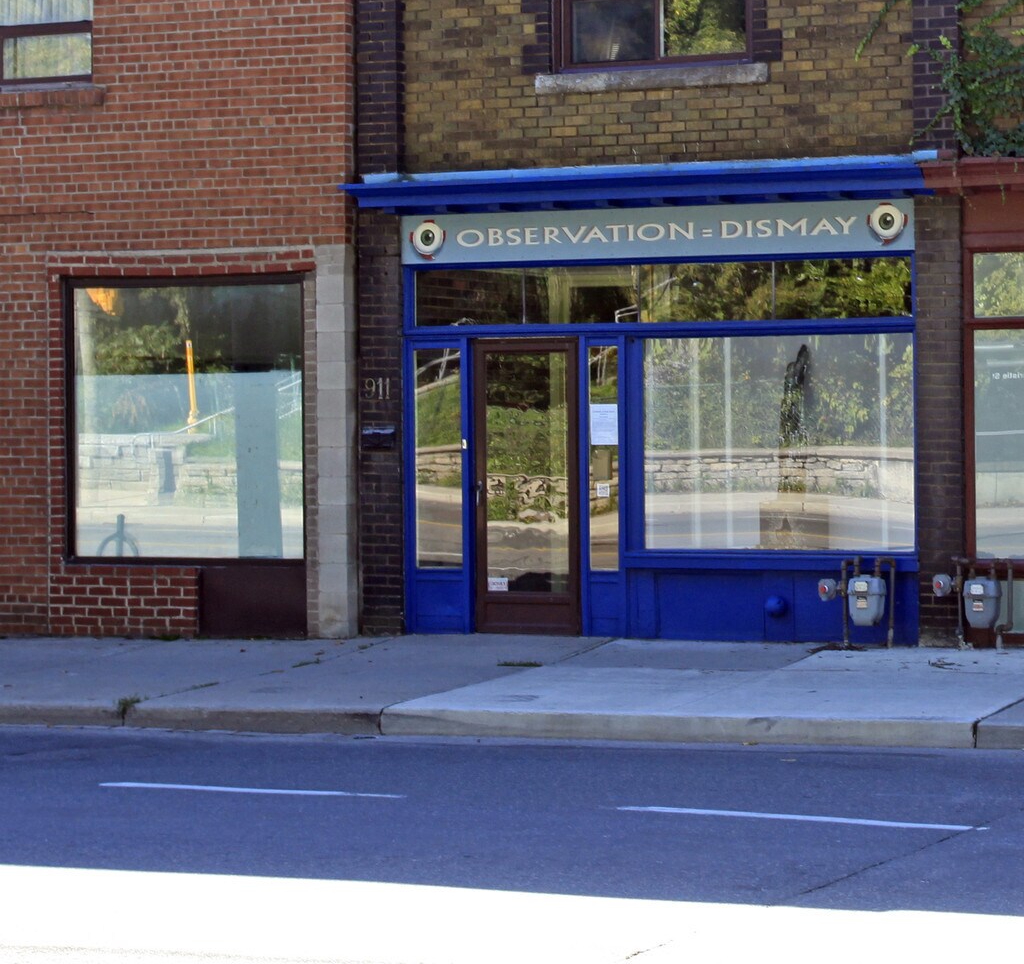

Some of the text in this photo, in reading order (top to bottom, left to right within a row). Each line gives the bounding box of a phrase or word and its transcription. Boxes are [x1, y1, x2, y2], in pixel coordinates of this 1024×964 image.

[456, 222, 695, 247] OBSERVATION
[719, 216, 857, 239] DISMAY
[364, 377, 390, 400] 911
